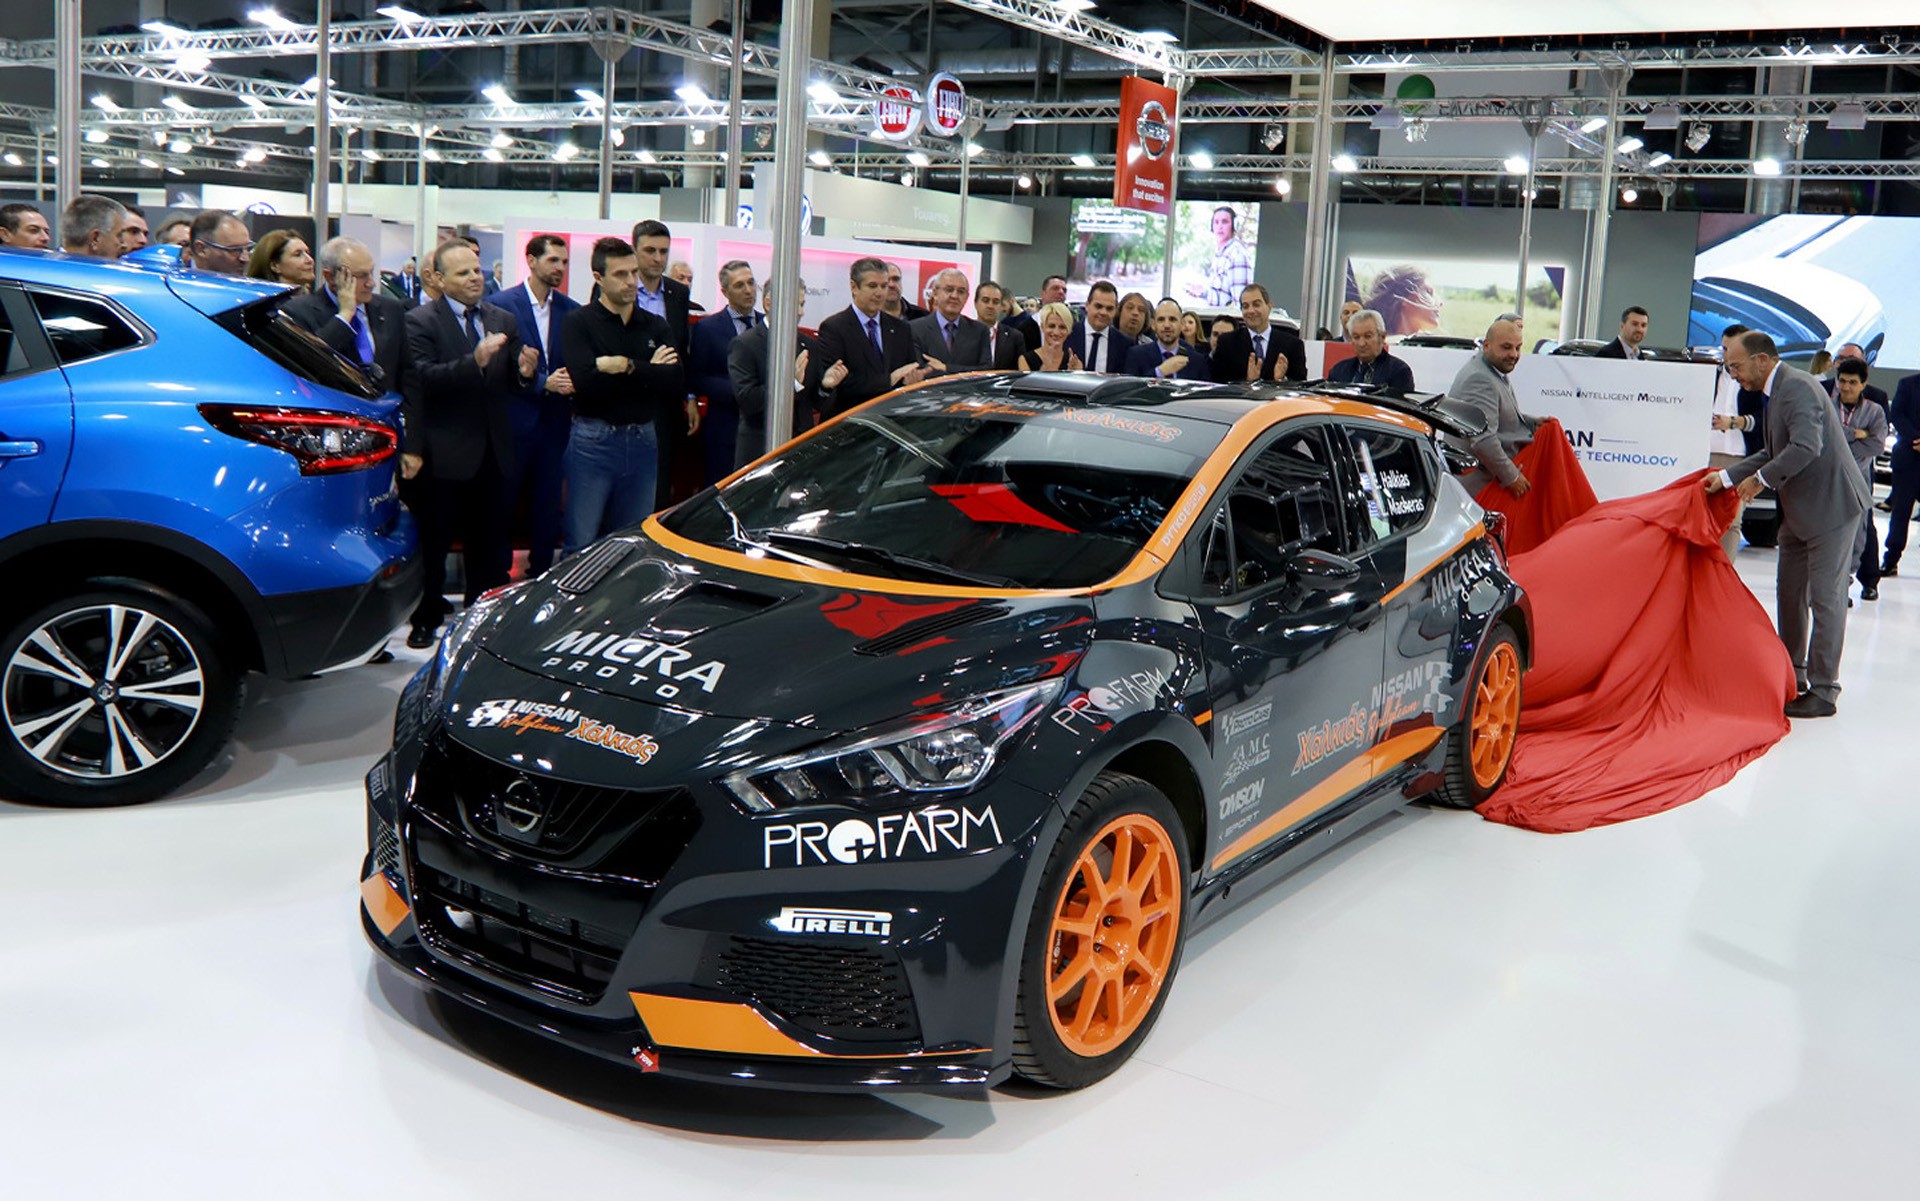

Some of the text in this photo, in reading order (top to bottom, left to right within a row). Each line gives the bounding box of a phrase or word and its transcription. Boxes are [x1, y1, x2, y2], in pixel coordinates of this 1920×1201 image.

[938, 88, 963, 120] FIAT
[1133, 188, 1144, 200] that
[1135, 175, 1164, 190] Innovation
[1541, 387, 1684, 404] NISSAN INTELLIGENT MOBILITY
[1587, 450, 1678, 467] TECHNOLOGY
[1380, 470, 1410, 488] Halkias
[1432, 548, 1491, 608] MICRA
[1441, 576, 1493, 617] PROTO
[542, 630, 725, 693] MICRA
[542, 657, 680, 699] PROTO
[1371, 665, 1424, 710] NISSAN
[513, 700, 580, 723] NISSAN
[1051, 667, 1176, 736] PROFARM
[764, 804, 1003, 868] PROFARM
[774, 907, 893, 936] PIRELLI
